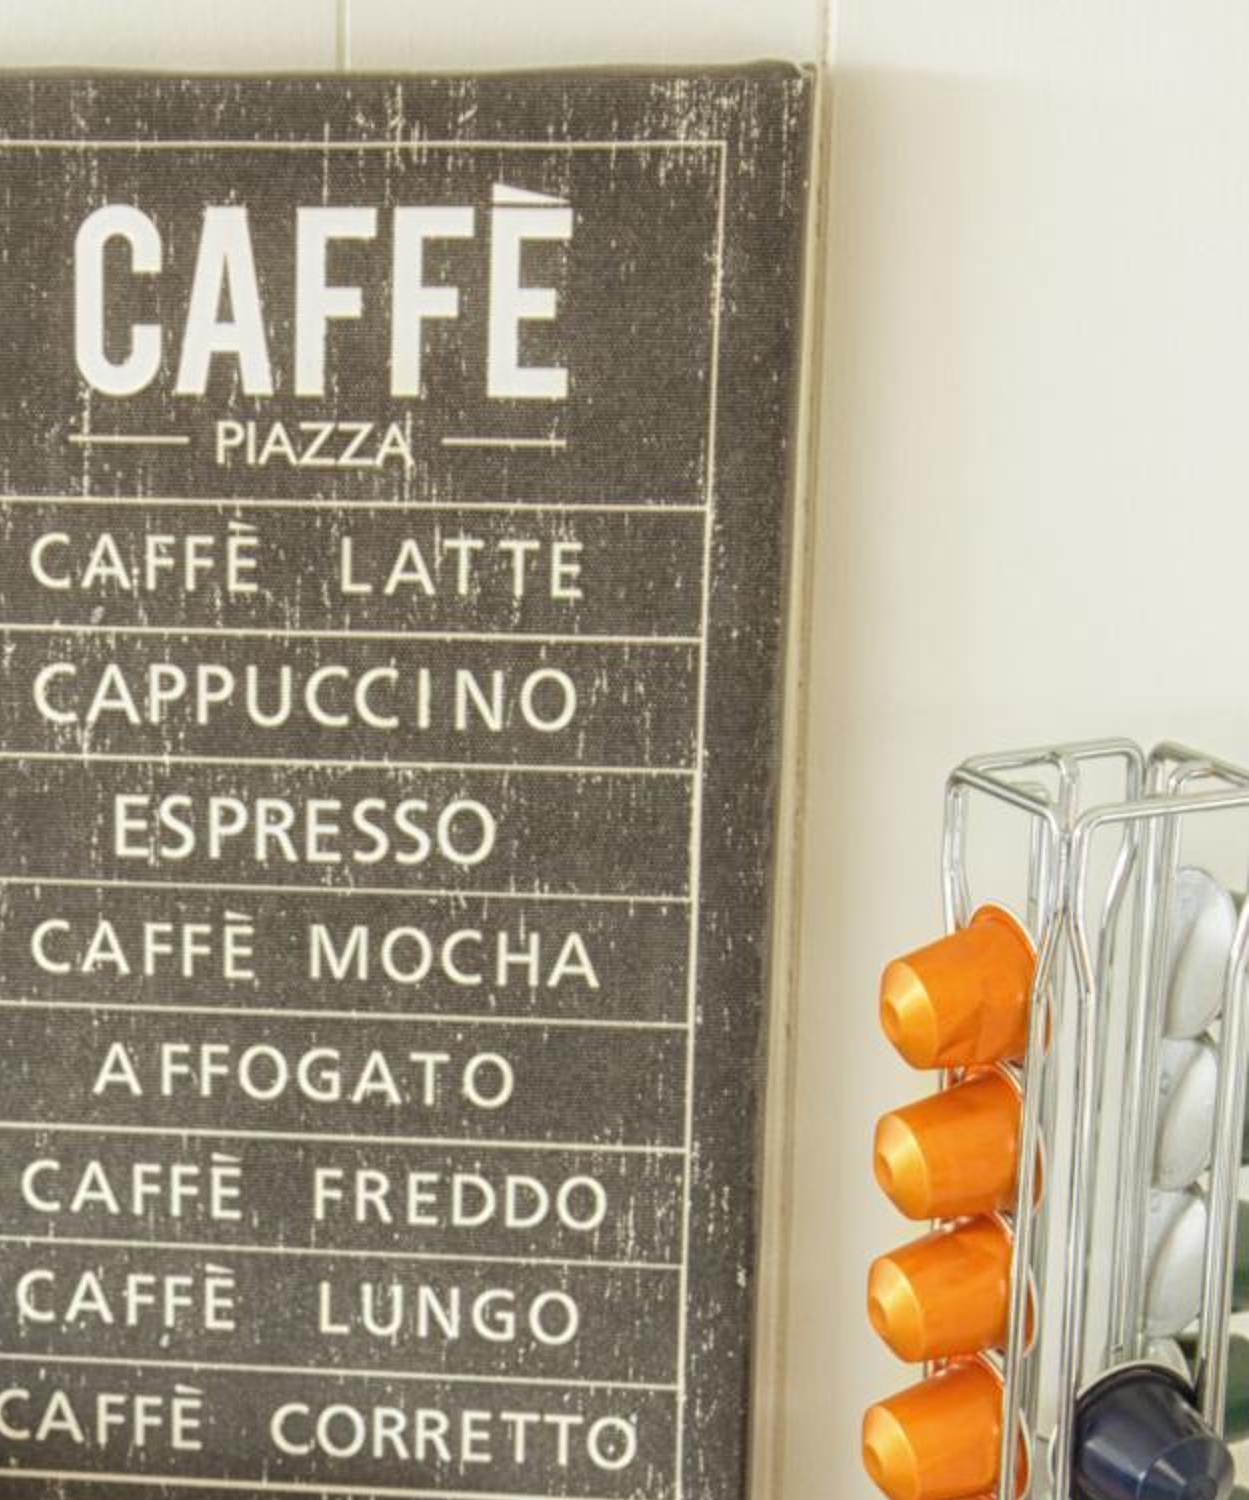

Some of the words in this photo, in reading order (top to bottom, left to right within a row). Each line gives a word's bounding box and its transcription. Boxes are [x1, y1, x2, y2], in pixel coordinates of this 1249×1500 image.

[73, 182, 575, 401] CAFFÈ
[215, 419, 413, 467] PIAZZA
[30, 521, 260, 595] CAFFÈ
[340, 534, 584, 599] LATTE
[32, 660, 578, 733] CAPPUCCINO
[113, 793, 498, 865] ESPRESSO
[30, 910, 256, 981] CAFFÈ
[309, 922, 601, 990] MOCHA
[92, 1041, 515, 1109] AFFOGATO
[20, 1151, 243, 1221] CAFFÈ
[313, 1166, 609, 1231] FREDDO
[16, 1262, 236, 1332] CAFFÈ
[318, 1278, 580, 1346] LUNGO
[269, 1401, 638, 1471] CORRETTO
